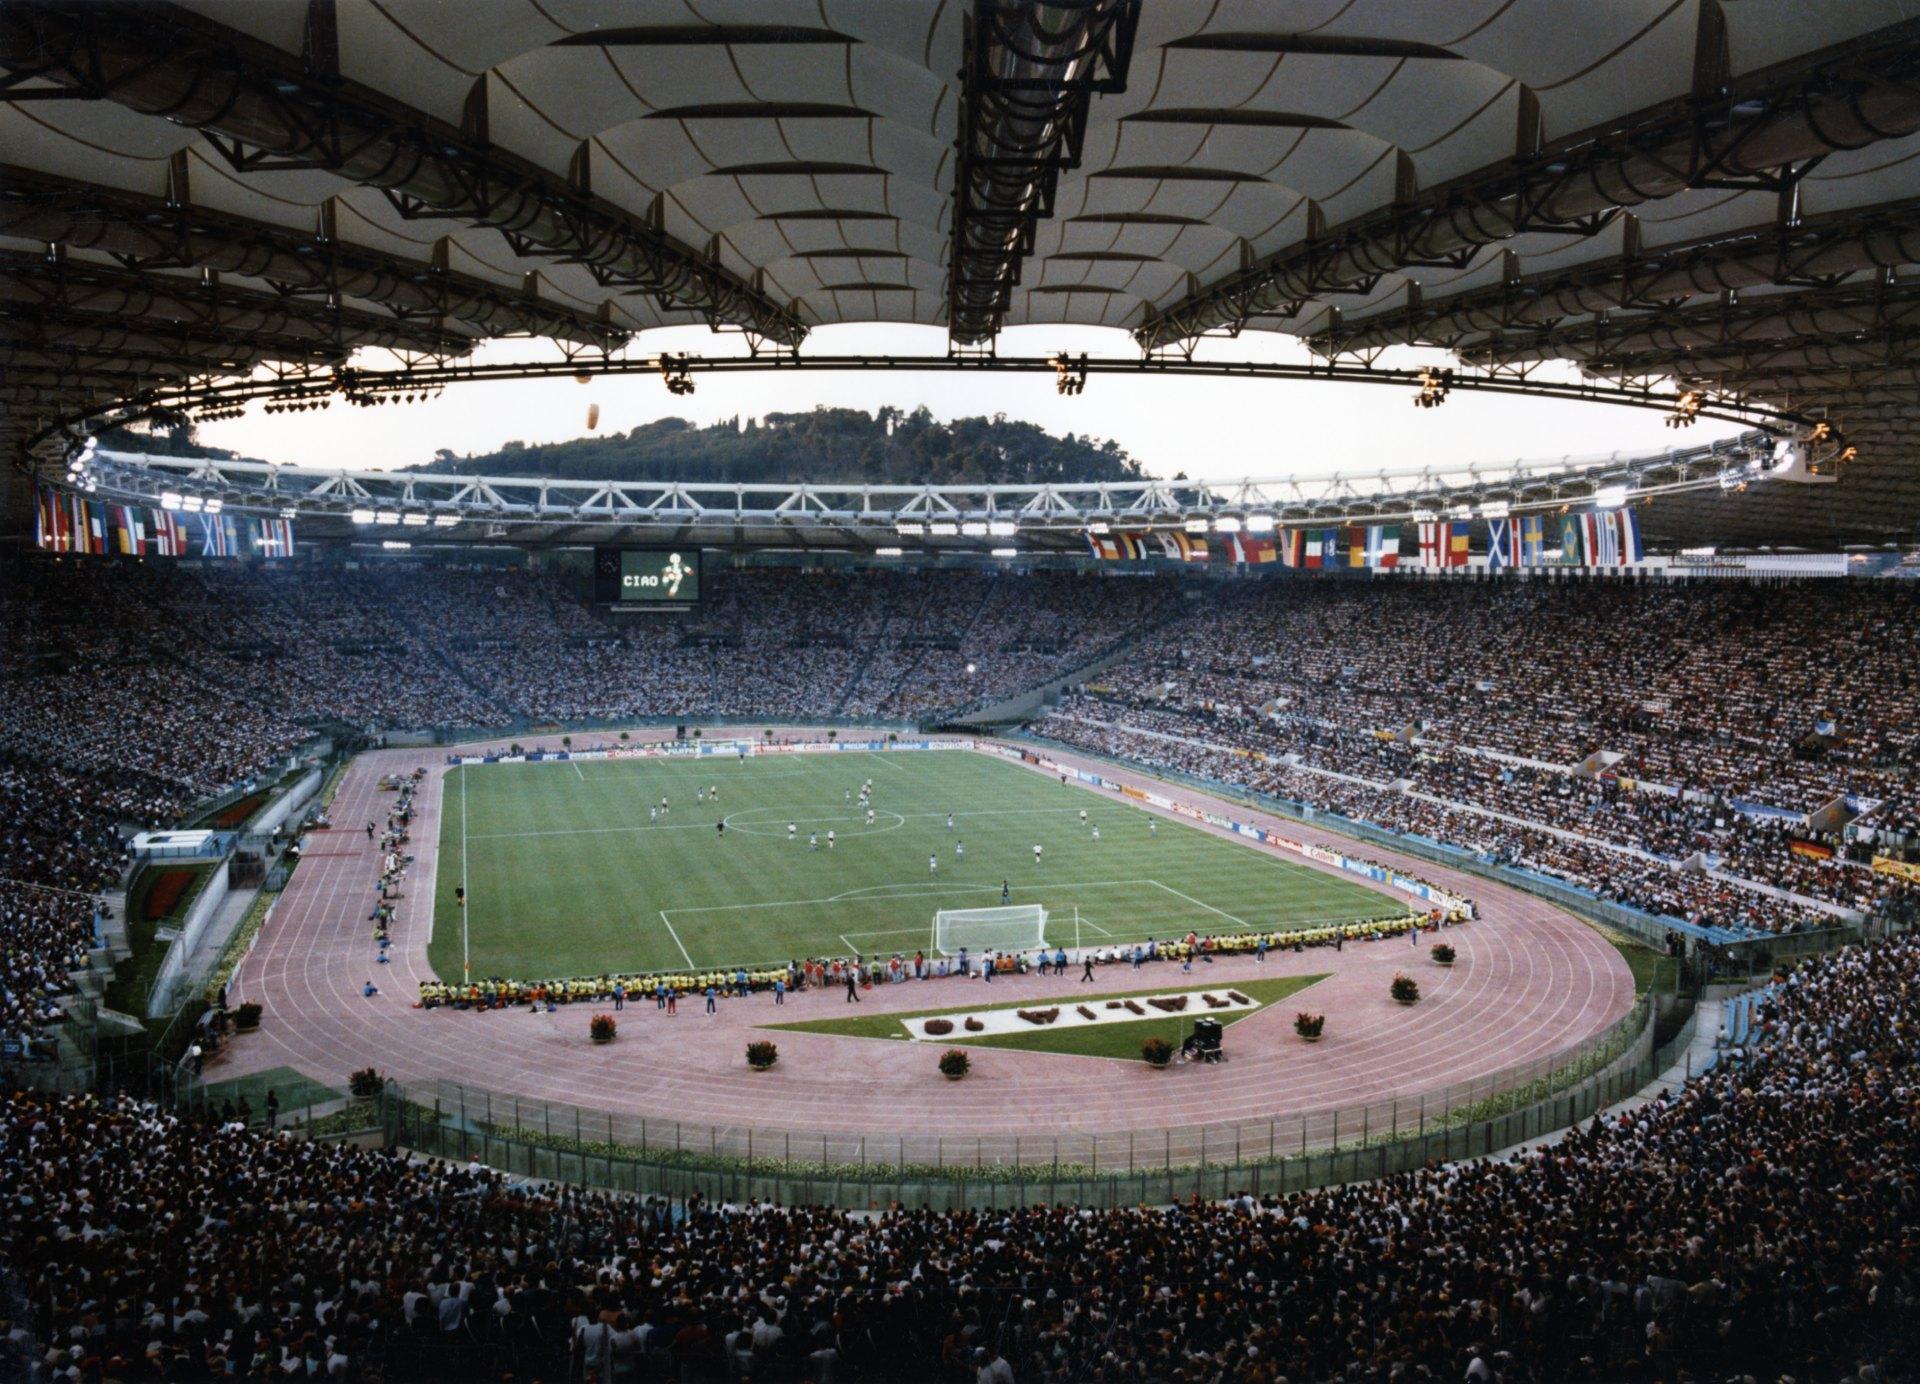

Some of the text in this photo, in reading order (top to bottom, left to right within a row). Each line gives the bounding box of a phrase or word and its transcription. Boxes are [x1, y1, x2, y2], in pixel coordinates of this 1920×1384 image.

[623, 575, 658, 587] CIAO
[1311, 848, 1335, 864] Canon
[1017, 990, 1250, 1025] ITALIA
